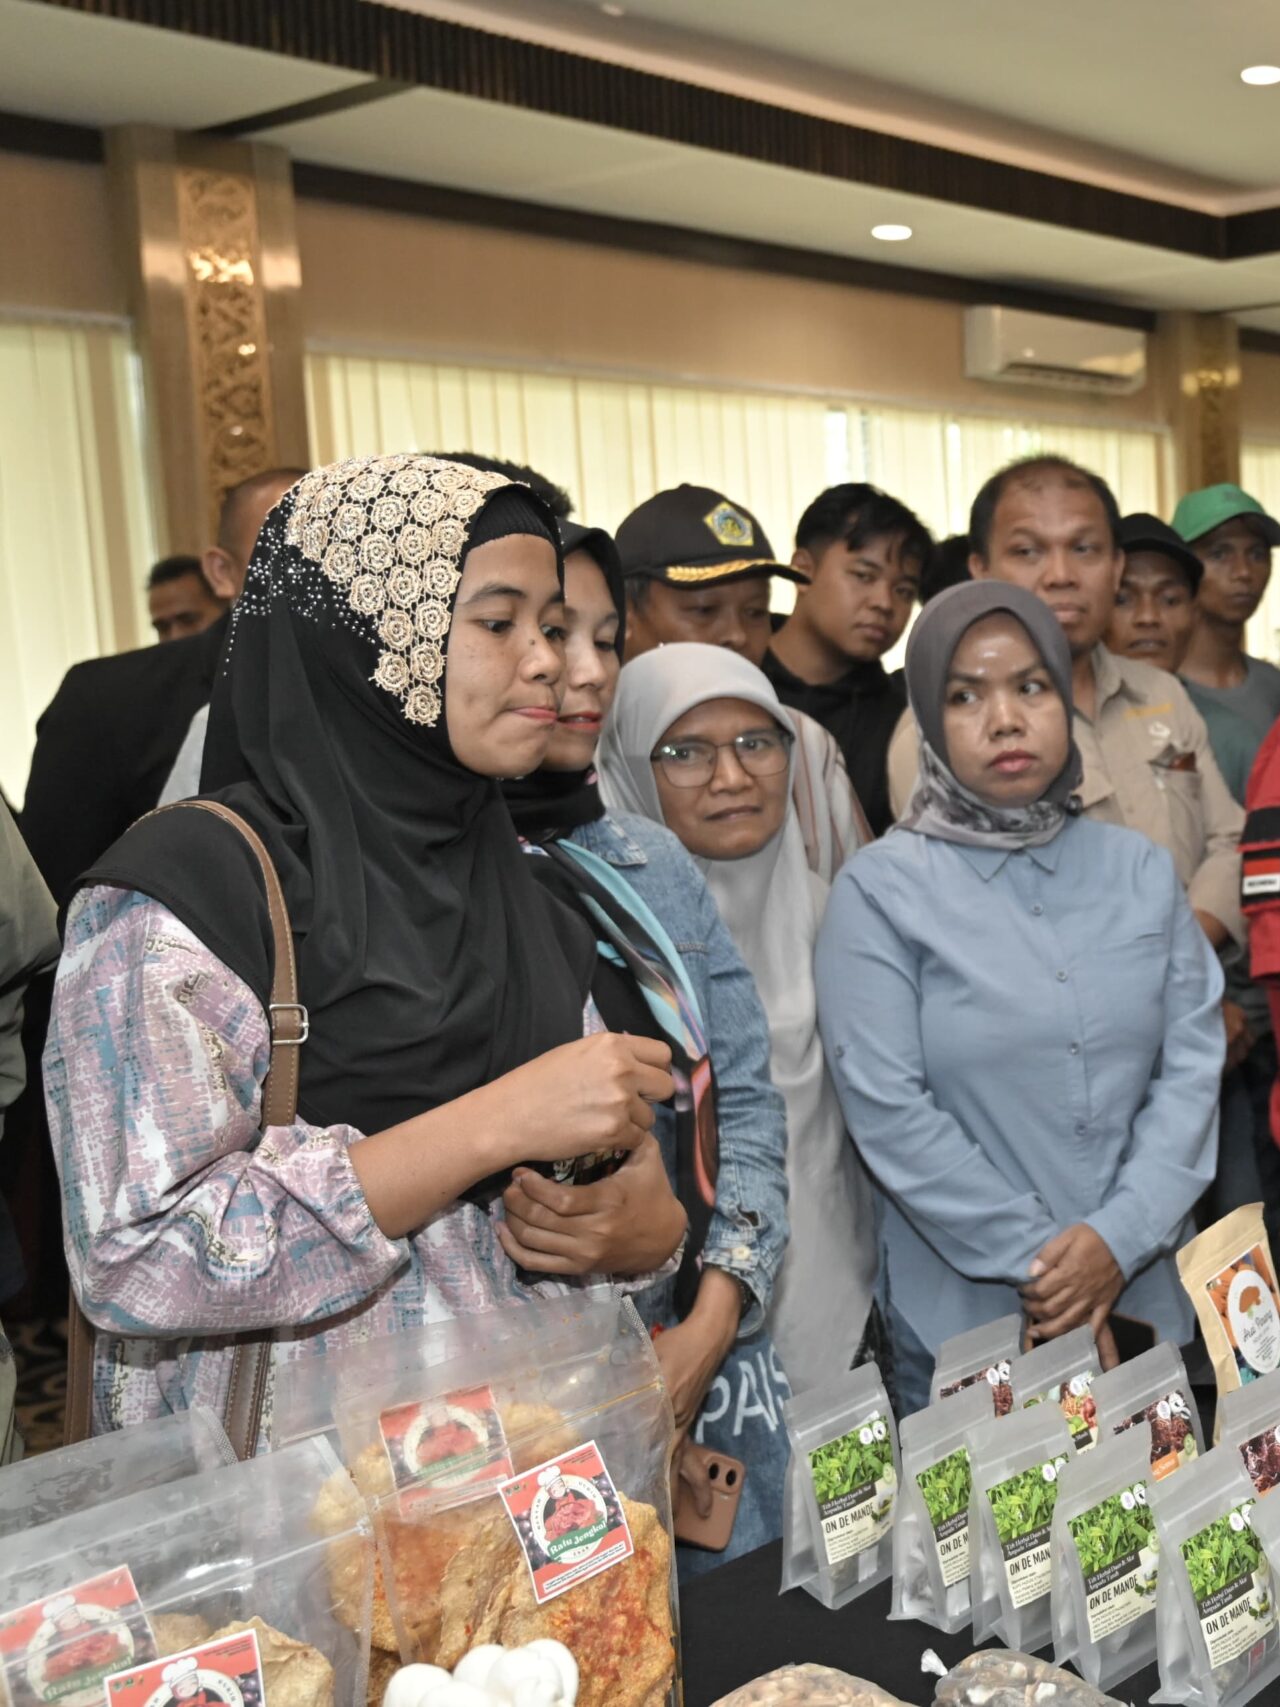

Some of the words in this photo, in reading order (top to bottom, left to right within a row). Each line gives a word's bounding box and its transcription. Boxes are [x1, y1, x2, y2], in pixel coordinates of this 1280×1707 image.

[825, 1519, 837, 1534] ON
[839, 1515, 850, 1528] DE
[850, 1503, 873, 1522] MANDE
[549, 1537, 573, 1556] Ratu
[574, 1520, 607, 1545] Jengkol
[940, 1541, 952, 1556] ON
[953, 1537, 962, 1550] DE
[1009, 1561, 1021, 1576] ON
[1021, 1556, 1032, 1570] DE
[1032, 1547, 1051, 1565] MAN
[1089, 1594, 1100, 1610] ON
[1102, 1588, 1113, 1603] DE
[1113, 1574, 1138, 1598] MANDE
[1206, 1619, 1219, 1635] ON
[1219, 1612, 1230, 1628] DE
[1229, 1596, 1249, 1621] MANDE
